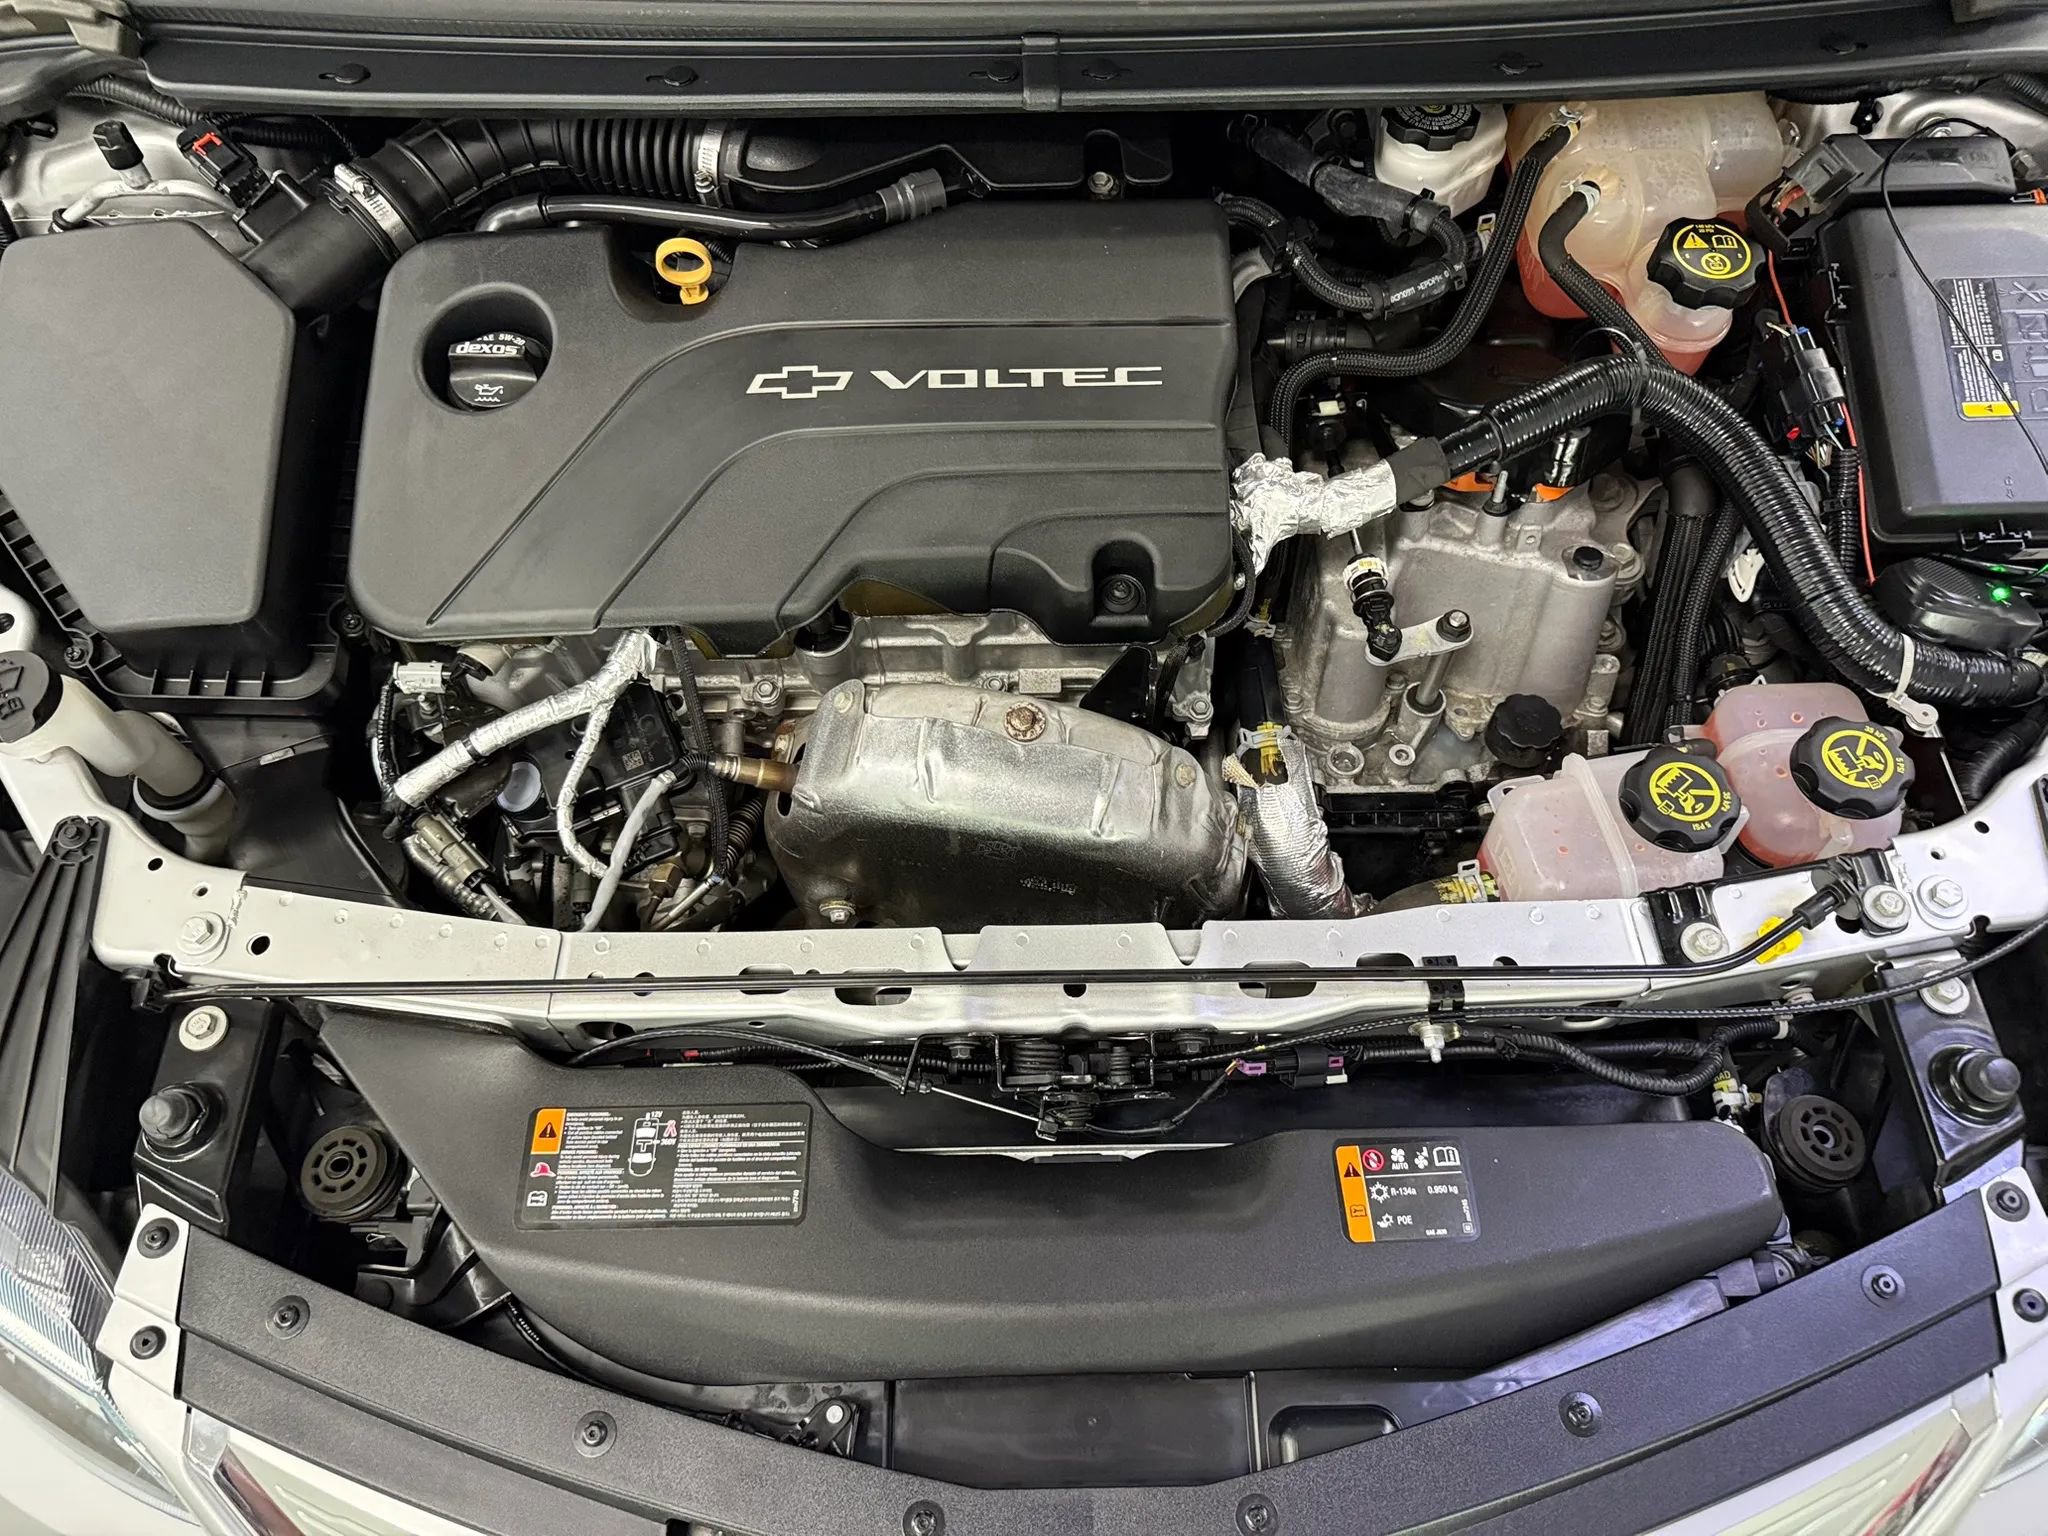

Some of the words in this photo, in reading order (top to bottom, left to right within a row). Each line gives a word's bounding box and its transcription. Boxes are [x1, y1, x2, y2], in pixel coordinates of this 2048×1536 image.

[455, 341, 518, 355] dexos
[870, 366, 1163, 390] VOLTEC
[651, 1110, 663, 1118] 12V
[1391, 1162, 1409, 1170] AUTO
[1391, 1186, 1417, 1196] R-134a
[1448, 1184, 1459, 1195] kg
[1396, 1215, 1413, 1225] POE
